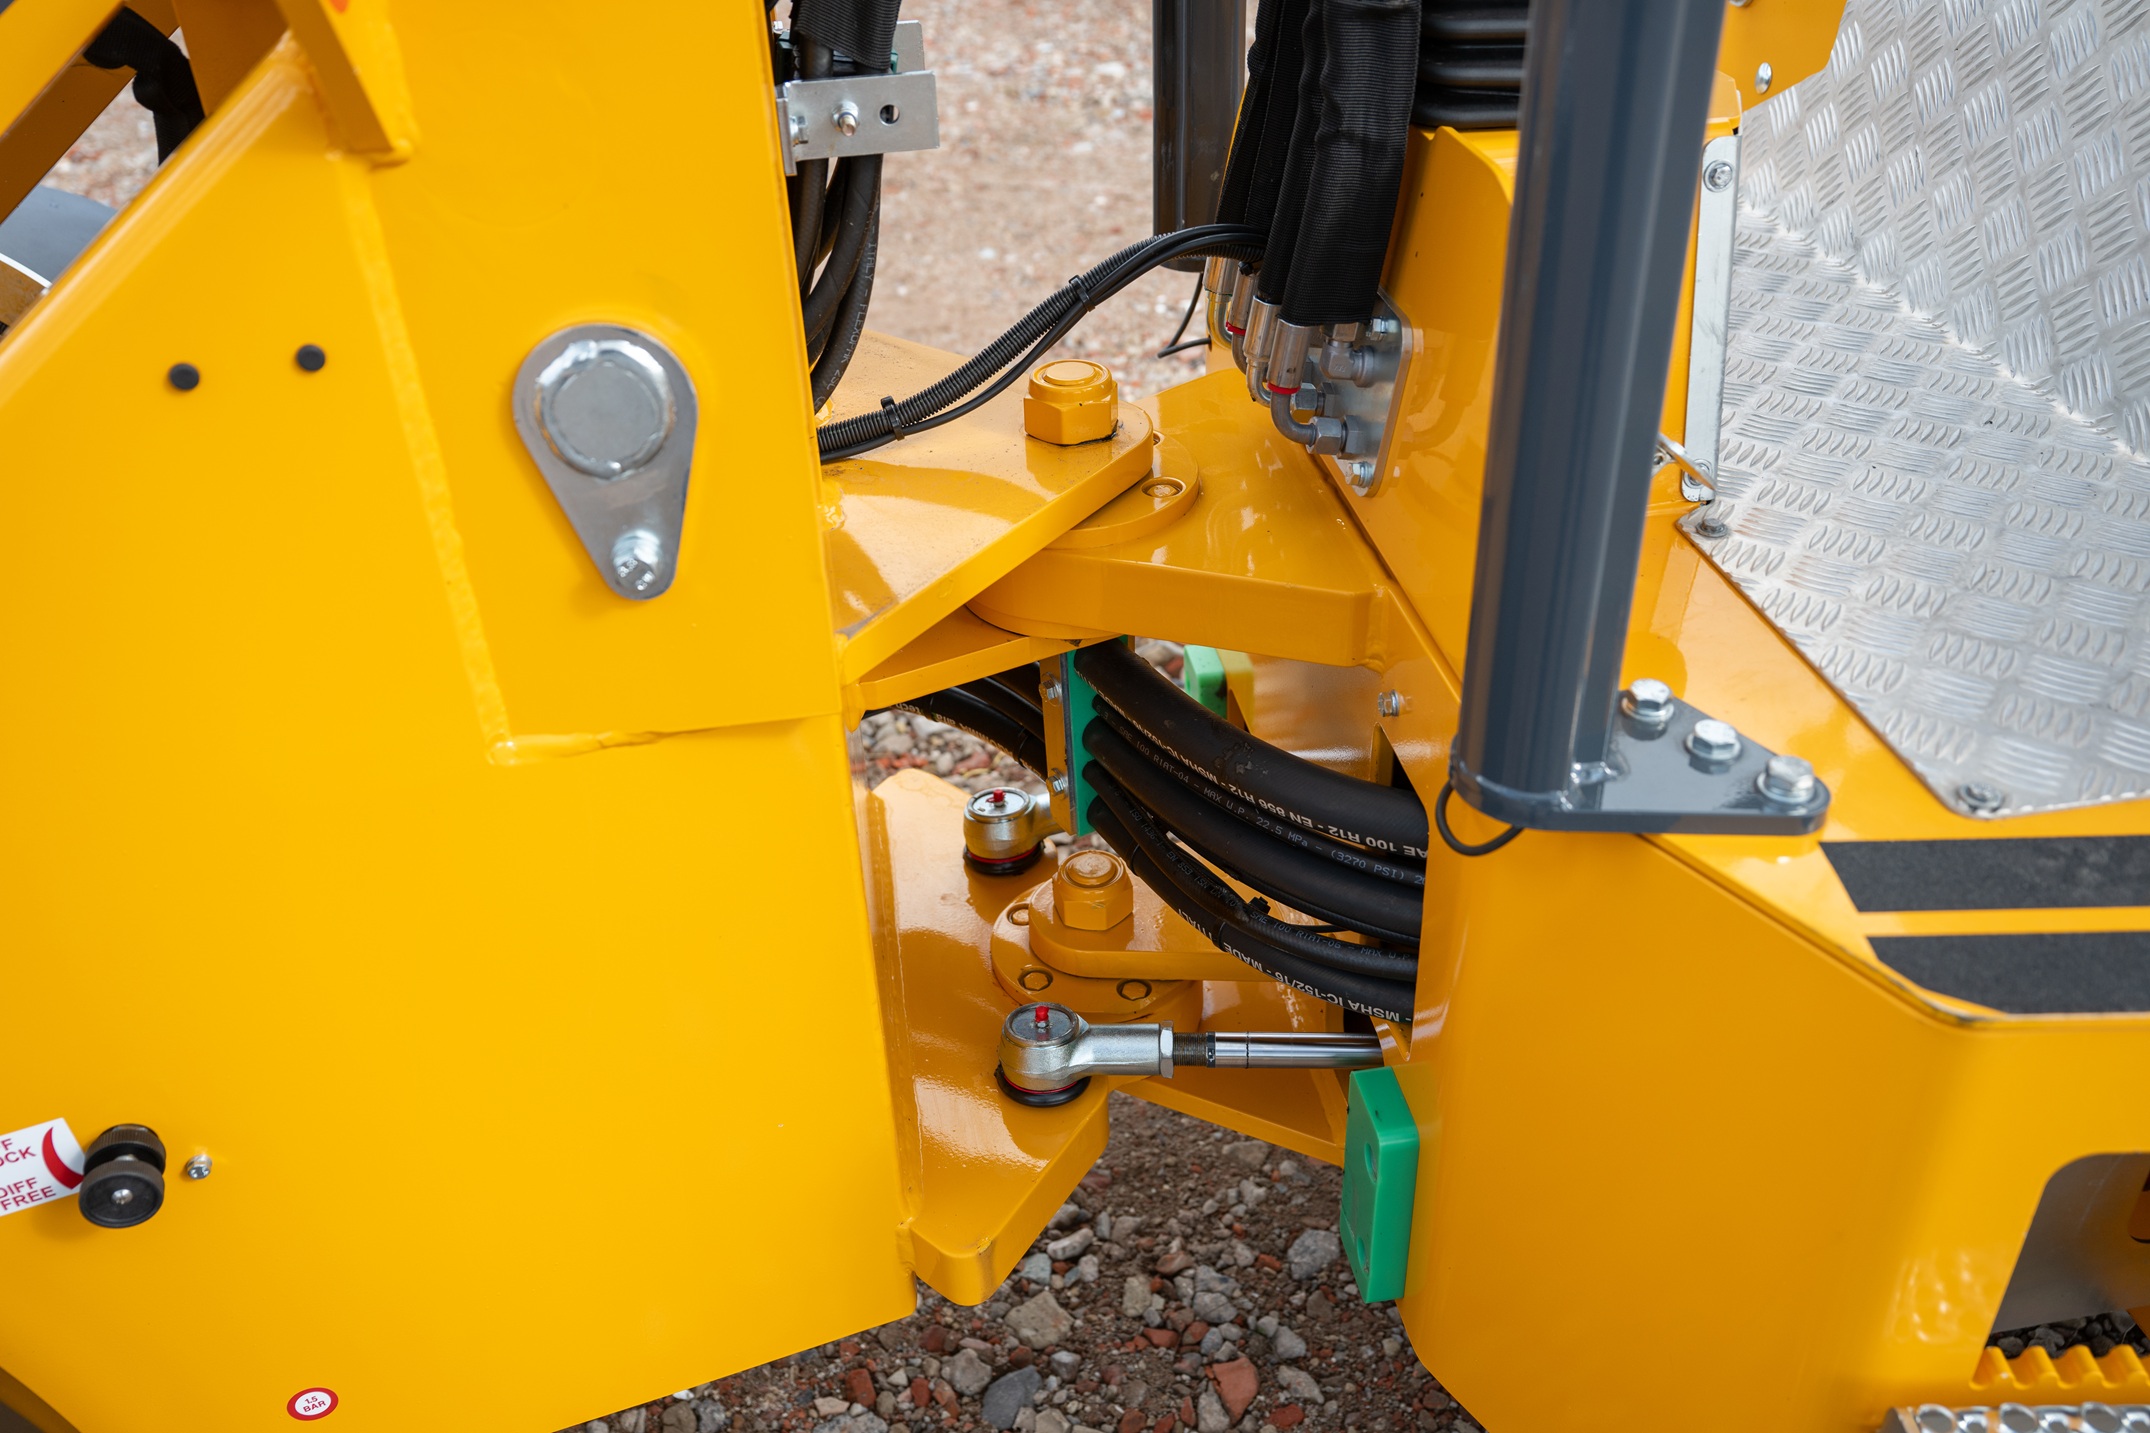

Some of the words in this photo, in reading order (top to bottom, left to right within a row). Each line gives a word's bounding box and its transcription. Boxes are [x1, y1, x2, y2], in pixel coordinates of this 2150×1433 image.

[864, 243, 877, 281] ITALY
[1182, 757, 1218, 785] MSHA
[1119, 724, 1133, 744] SAE
[1136, 742, 1150, 757] 100
[1153, 753, 1190, 784] R1AT-04
[1203, 786, 1223, 805] MAX
[1256, 815, 1283, 836] 22.5
[1287, 831, 1308, 848] MPa
[1330, 849, 1367, 870] (3270
[1373, 863, 1405, 880] PSI)
[1229, 783, 1256, 805] R12
[1258, 798, 1286, 818] 856
[1289, 811, 1313, 829] EN
[1327, 825, 1361, 844] R12
[1365, 836, 1398, 852] 100
[1129, 807, 1143, 822] ISO
[1166, 850, 1179, 862] EN
[1178, 861, 1194, 876] 853
[1250, 911, 1269, 925] SAE
[1273, 921, 1292, 934] 100
[1360, 946, 1383, 958] MAX
[1222, 941, 1265, 973] MADE
[1274, 970, 1344, 1006] IC-152/16
[1347, 998, 1401, 1023] MSHA
[1, 1185, 57, 1211] FREE
[303, 1400, 326, 1413] BAR
[304, 1395, 318, 1405] 1.5
